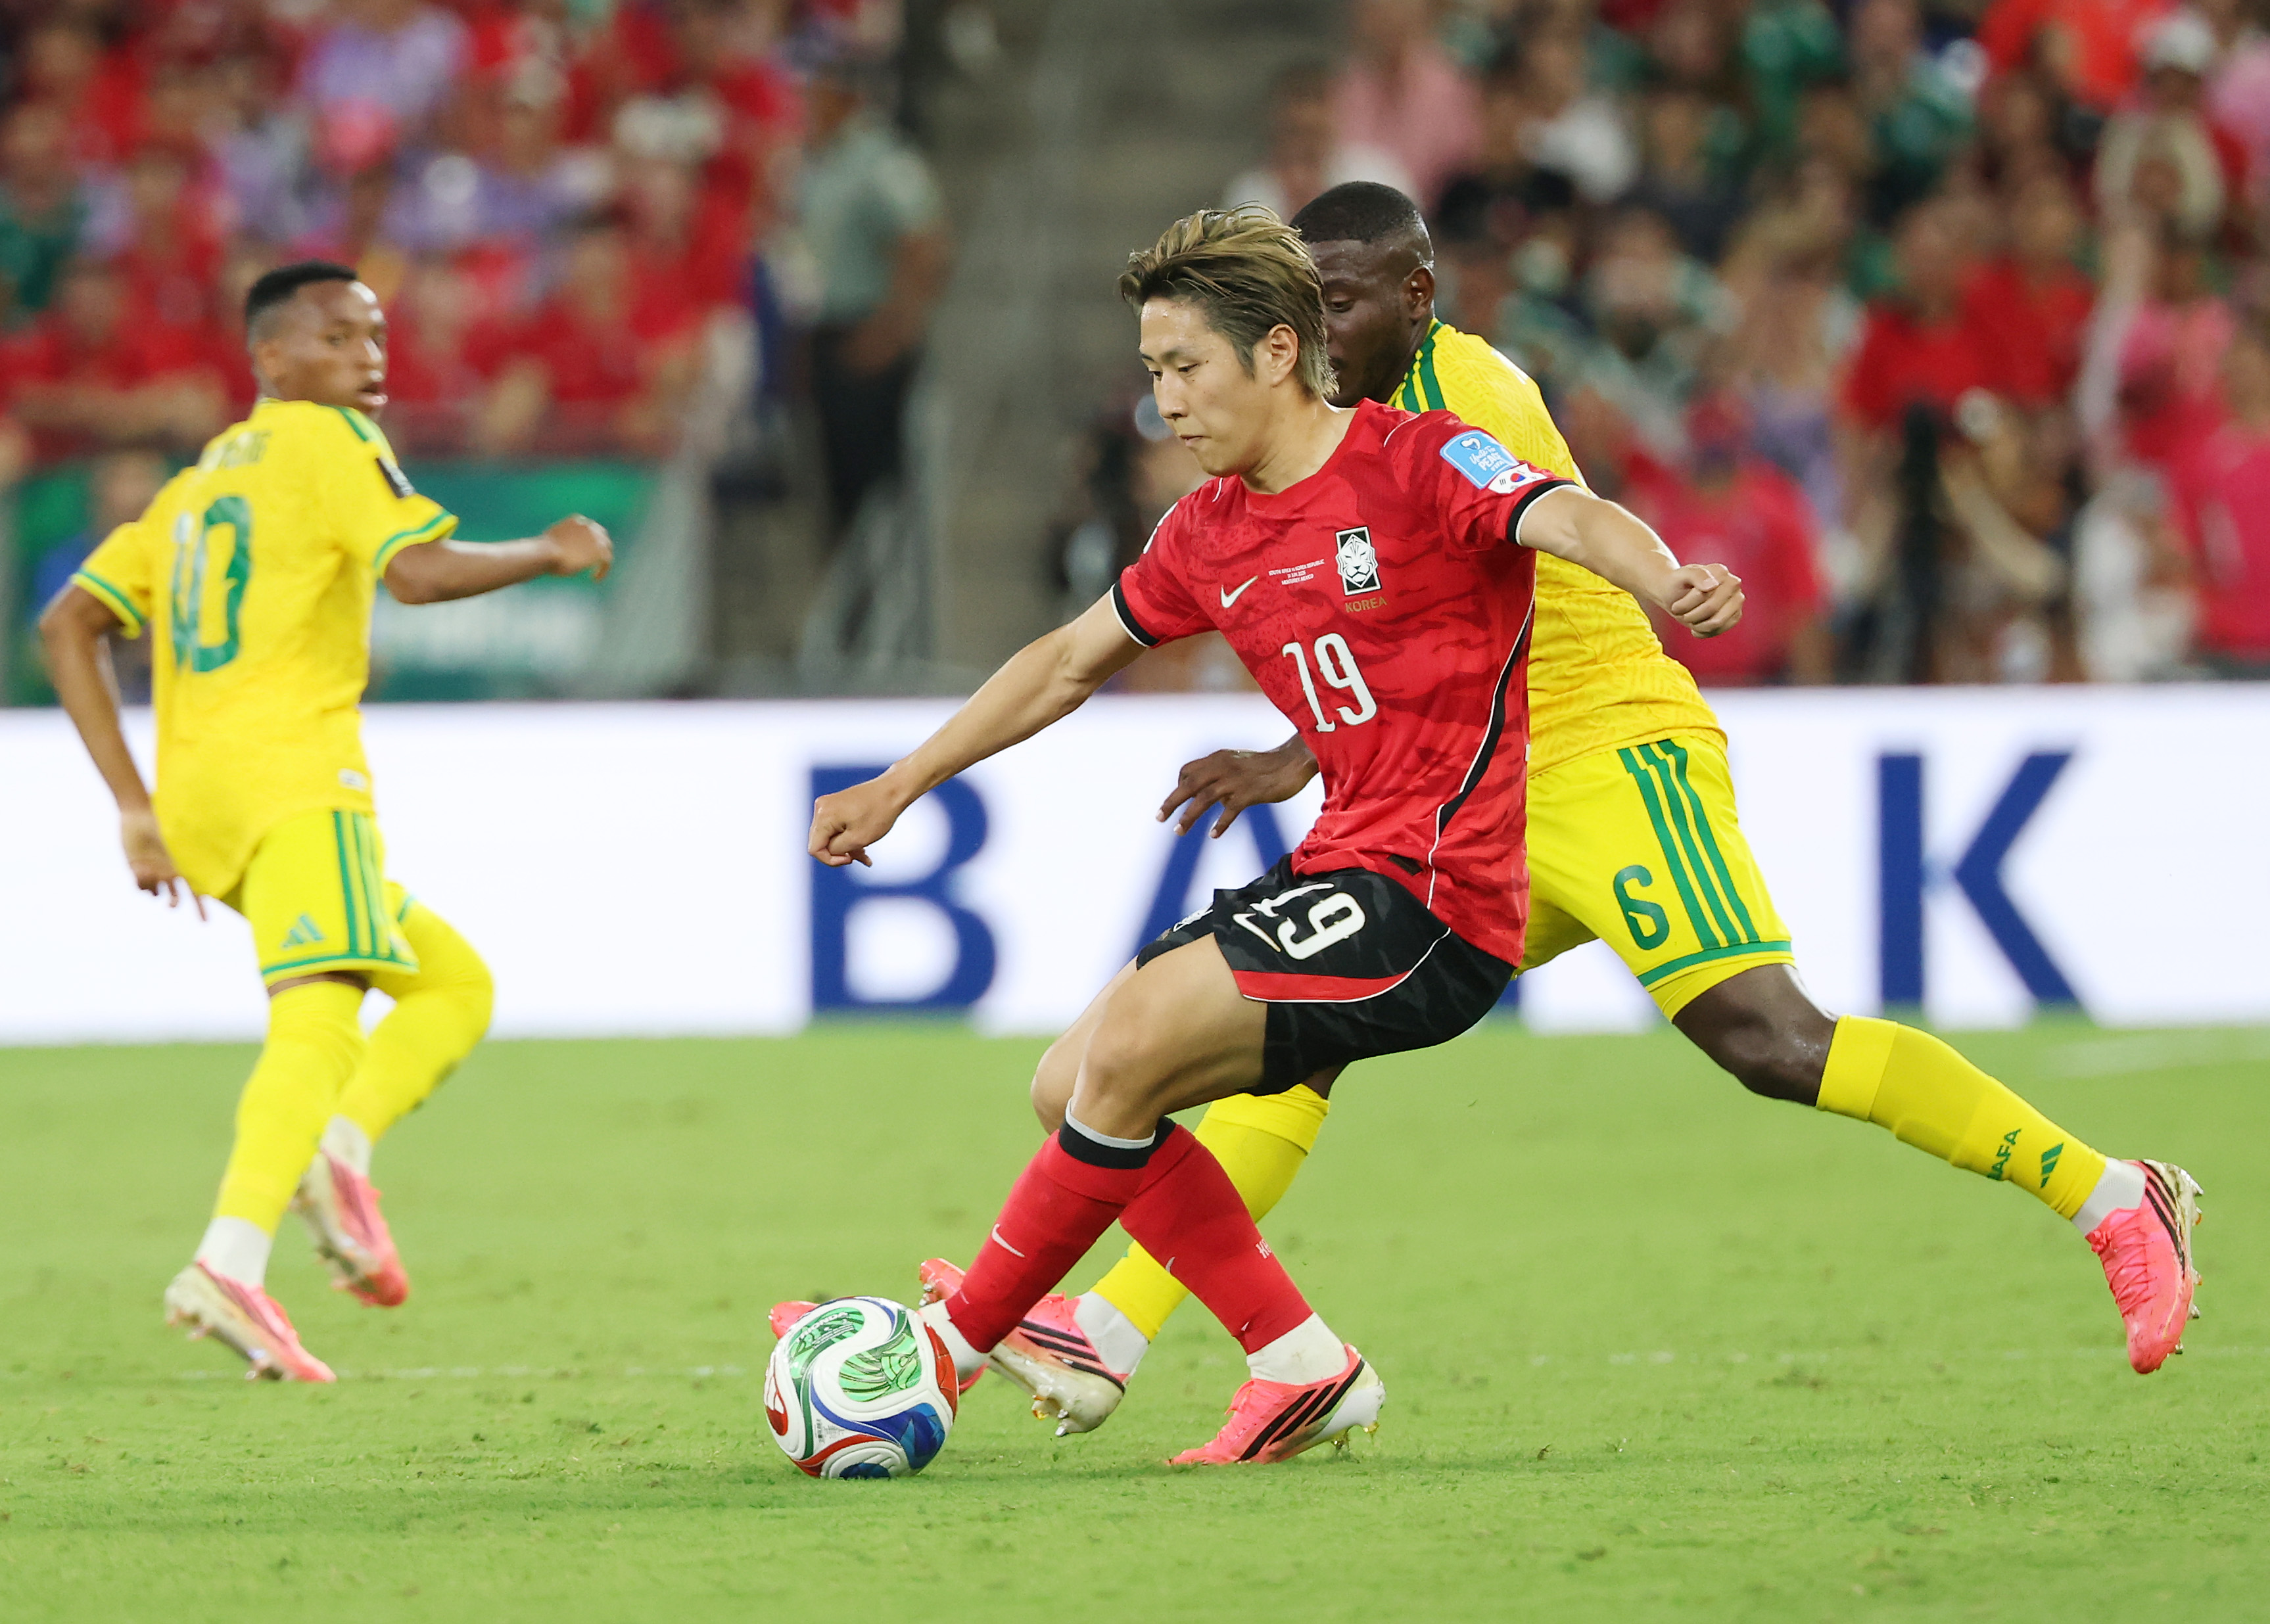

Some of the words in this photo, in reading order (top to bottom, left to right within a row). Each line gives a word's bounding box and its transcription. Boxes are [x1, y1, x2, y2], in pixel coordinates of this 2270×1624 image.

[172, 496, 251, 672] 10
[1344, 596, 1388, 613] KOREA
[1282, 633, 1377, 732] 19
[812, 753, 2084, 1013] BAK
[1250, 882, 1366, 960] 19
[1613, 864, 1670, 950] 6
